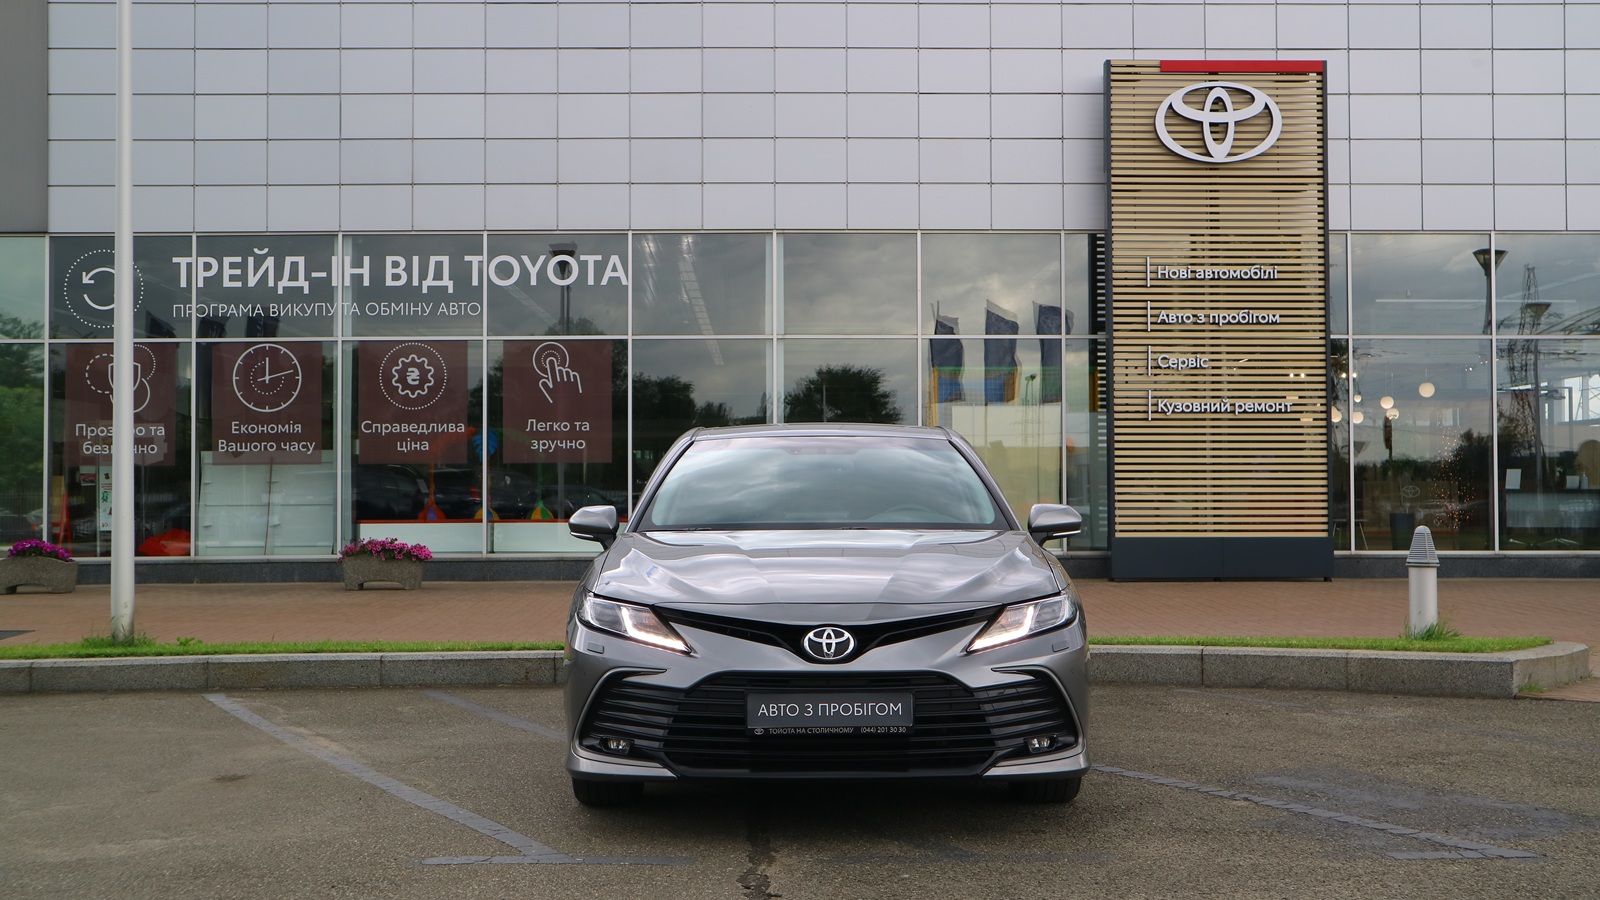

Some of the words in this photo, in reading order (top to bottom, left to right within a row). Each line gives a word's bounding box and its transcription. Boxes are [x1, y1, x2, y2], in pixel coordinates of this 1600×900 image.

[172, 247, 370, 295] ТРЕЙД-ІН
[385, 255, 454, 294] ВІД
[464, 254, 629, 287] TOYOTA
[1157, 265, 1192, 279] Нові
[1195, 265, 1278, 279] автомобілі
[173, 303, 264, 318] ПРОГРАМА
[269, 303, 338, 317] ВИКУПУ
[342, 302, 361, 316] ТА
[366, 302, 433, 317] ОБМІНУ
[437, 302, 481, 316] АВТО
[1157, 309, 1193, 324] Авто
[1196, 312, 1206, 324] з
[1209, 309, 1280, 327] пробігом
[1157, 354, 1209, 371] Сервіс
[1157, 398, 1231, 416] Кузовний
[1235, 402, 1293, 416] ремонт
[75, 423, 146, 440] Прозо
[149, 426, 166, 436] та
[231, 421, 302, 434] Економія
[361, 420, 465, 436] Справедлива
[525, 418, 571, 432] Легко
[574, 421, 590, 432] та
[82, 441, 158, 455] безно
[218, 439, 277, 452] Вашого
[280, 442, 316, 454] часу
[397, 438, 429, 451] ціна
[530, 439, 586, 453] зручно
[757, 703, 800, 717] АВТО
[803, 703, 814, 717] З
[818, 702, 902, 717] ПРОБІГОМ
[796, 727, 806, 735] НА
[806, 727, 854, 735] СТОЛИЧНОМУ
[860, 726, 876, 734] (044)
